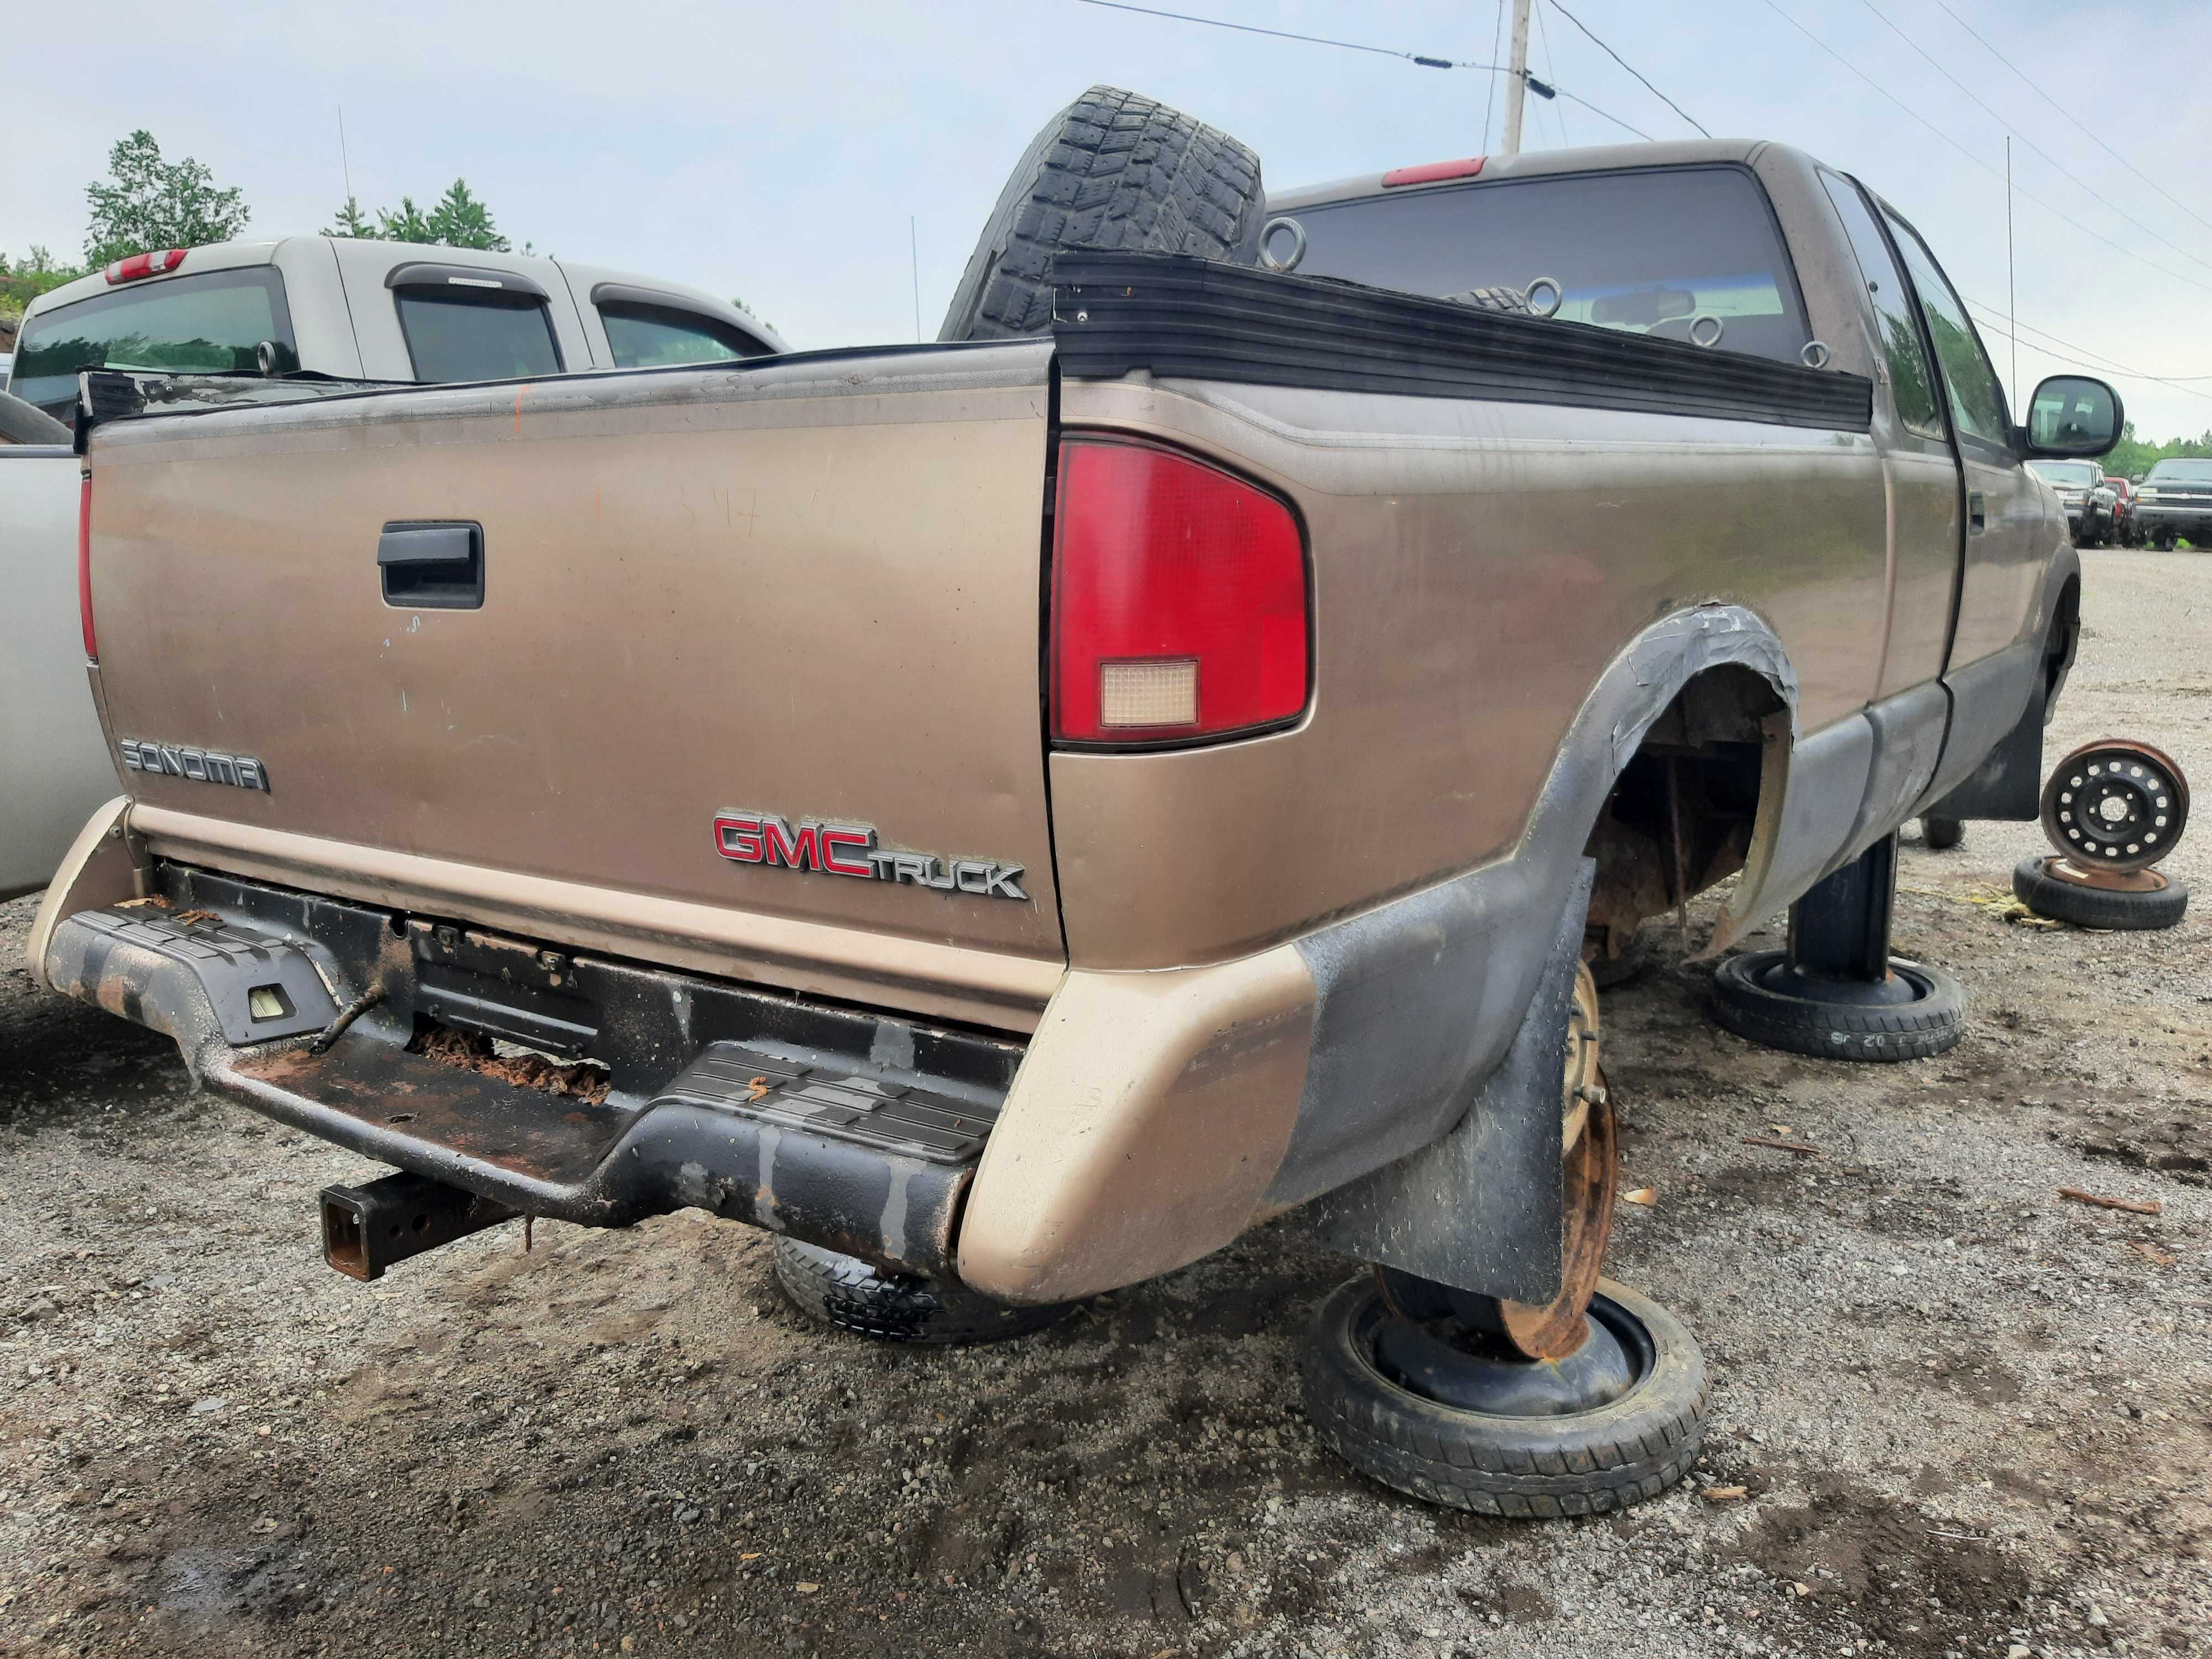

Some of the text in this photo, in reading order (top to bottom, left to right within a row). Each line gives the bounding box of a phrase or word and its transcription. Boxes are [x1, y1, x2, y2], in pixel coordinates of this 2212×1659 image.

[121, 739, 269, 794] SONOMA
[713, 810, 1029, 900] GMC TRUCK
